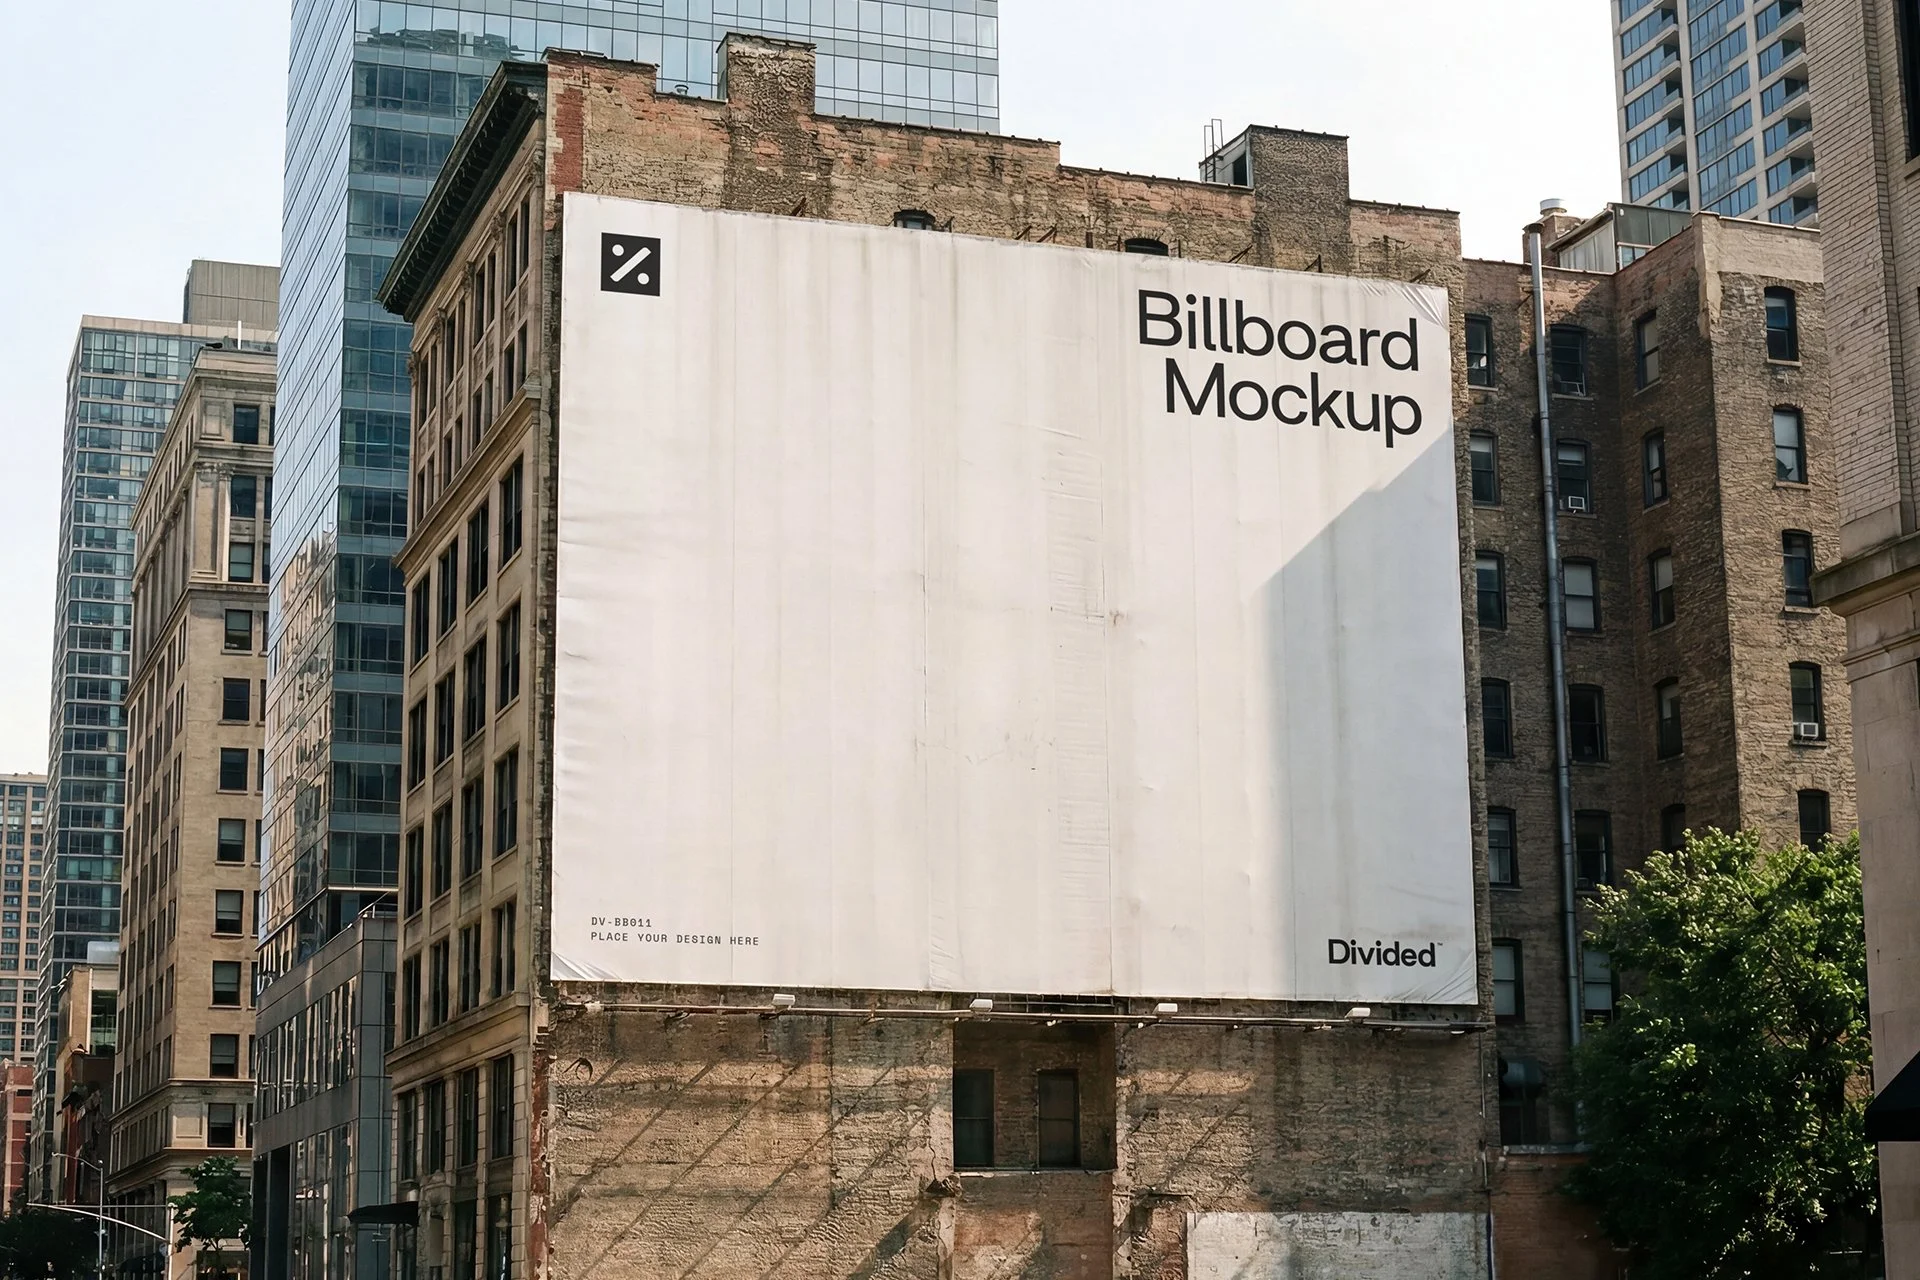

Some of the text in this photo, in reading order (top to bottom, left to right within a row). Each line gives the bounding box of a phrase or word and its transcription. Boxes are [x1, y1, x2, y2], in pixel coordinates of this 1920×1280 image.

[1138, 289, 1419, 372] Billboard
[1165, 357, 1422, 449] Mockup
[590, 931, 759, 946] PLACE YOUR DESIGN HERE
[591, 916, 652, 928] DV-BB011
